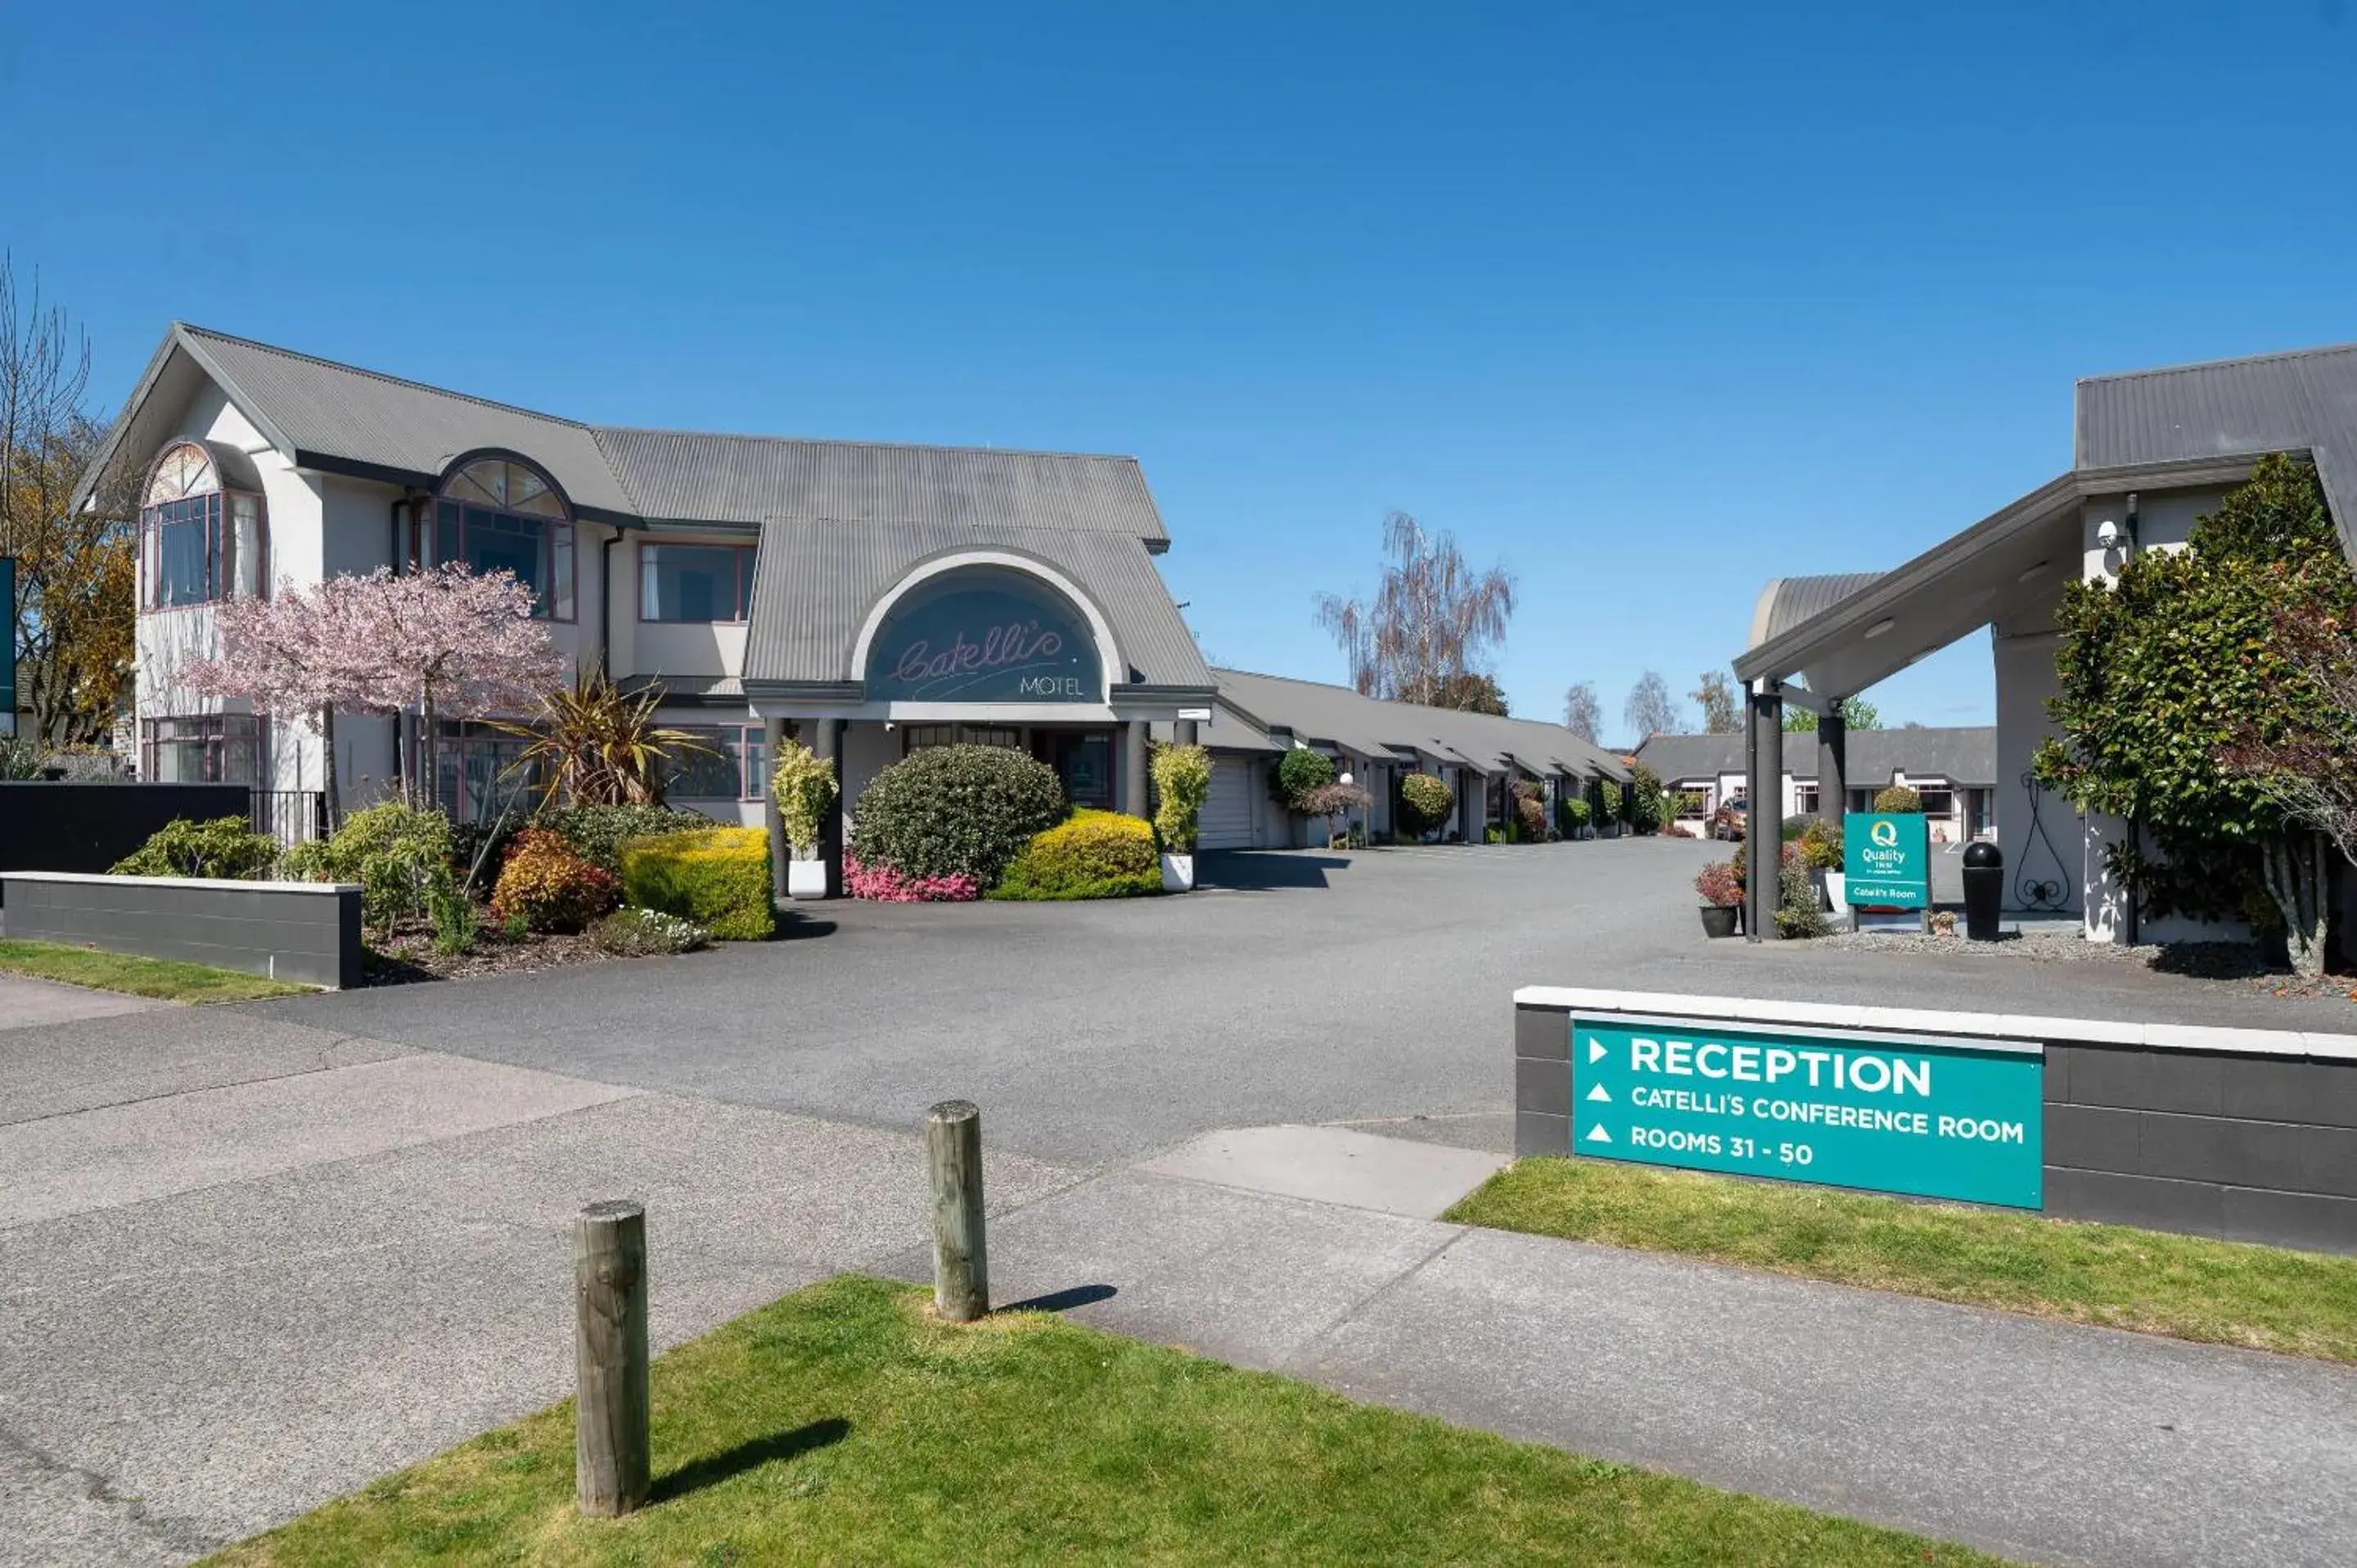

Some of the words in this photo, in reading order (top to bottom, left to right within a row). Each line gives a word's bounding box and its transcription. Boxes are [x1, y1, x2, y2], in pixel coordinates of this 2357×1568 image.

[888, 620, 1061, 681] Catelli's
[1021, 677, 1084, 696] MOTEL
[1871, 821, 1899, 847] Q
[1862, 848, 1905, 864] Quality
[1889, 889, 1917, 899] Room
[1631, 1038, 1931, 1097] RECEPTION
[1631, 1086, 1745, 1116] CATELLI'S
[1752, 1097, 1929, 1134] CONFERENCE
[1938, 1115, 2024, 1144] ROOM
[1631, 1126, 1722, 1155] ROOMS
[1729, 1137, 1754, 1159] 31
[1779, 1142, 1813, 1165] 50
